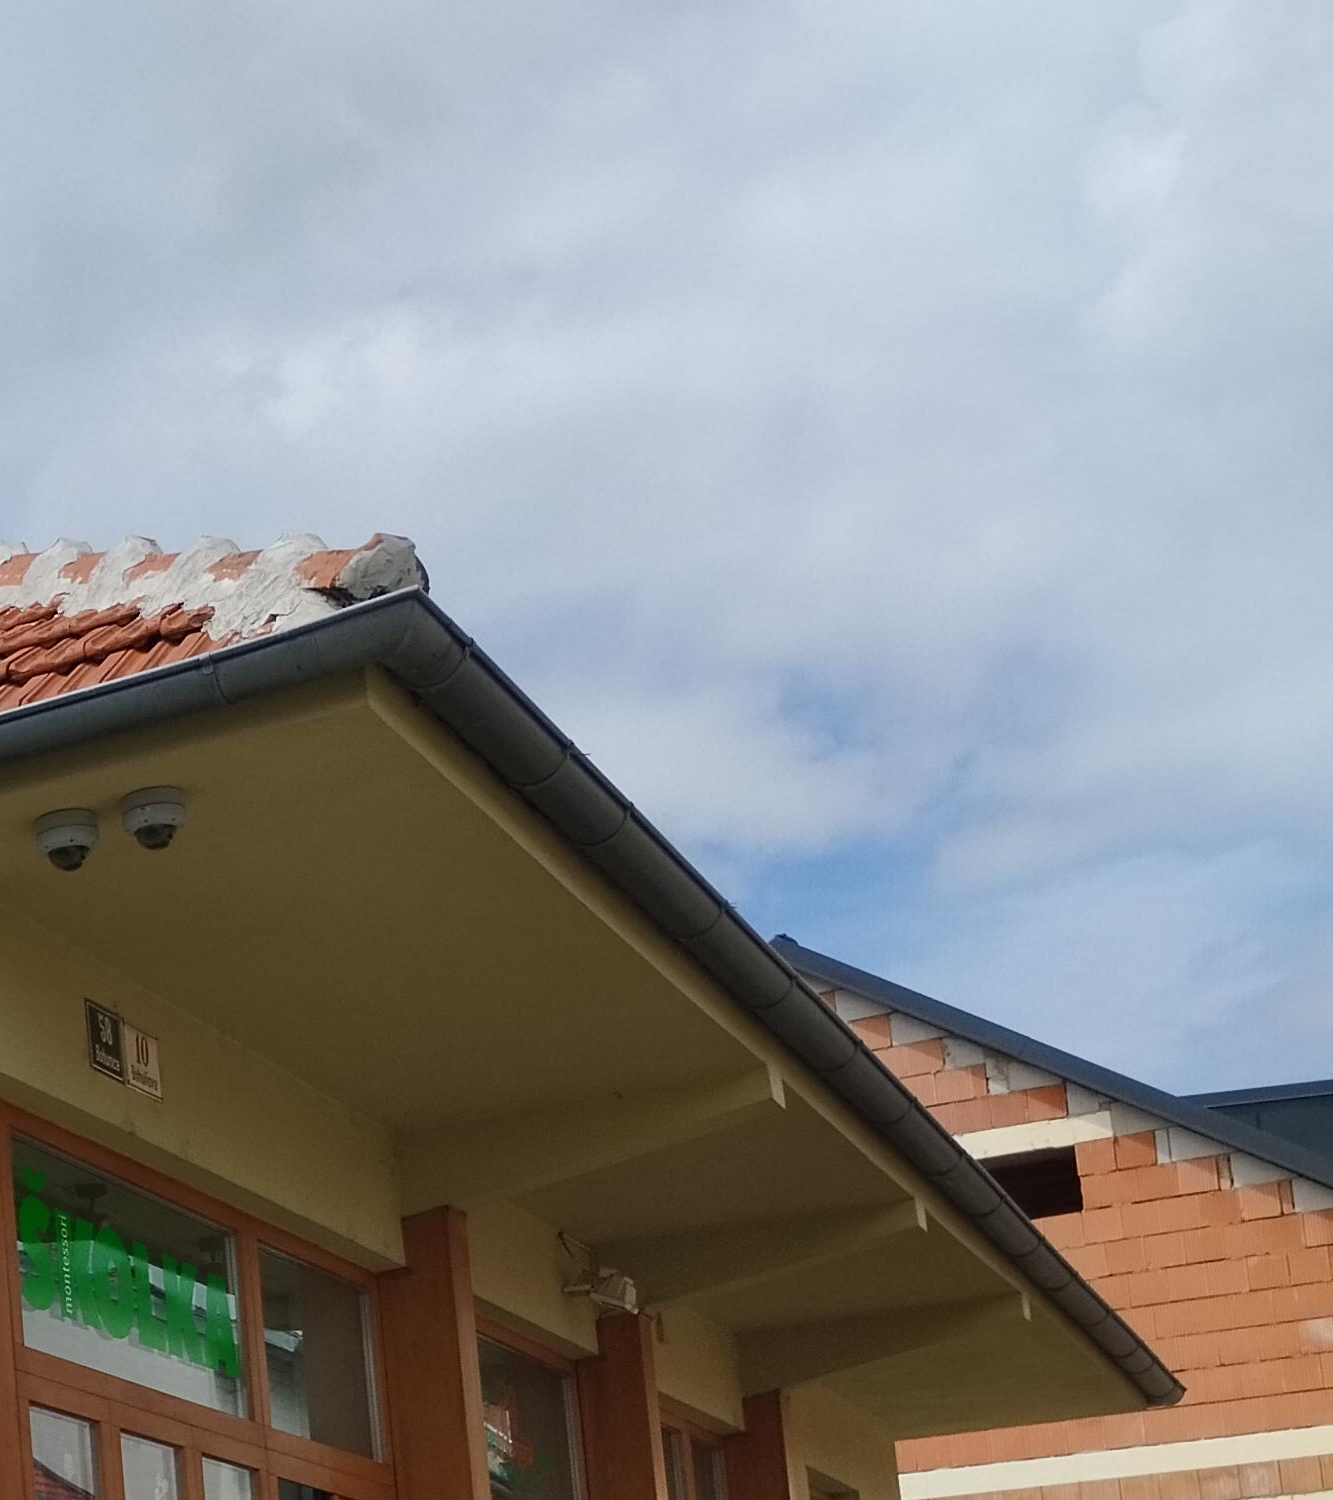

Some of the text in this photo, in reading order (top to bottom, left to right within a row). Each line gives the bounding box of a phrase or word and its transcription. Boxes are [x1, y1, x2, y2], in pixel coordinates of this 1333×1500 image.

[135, 1033, 149, 1067] 10
[18, 1163, 240, 1378] ŠKOLKA
[58, 1213, 74, 1315] montessori
